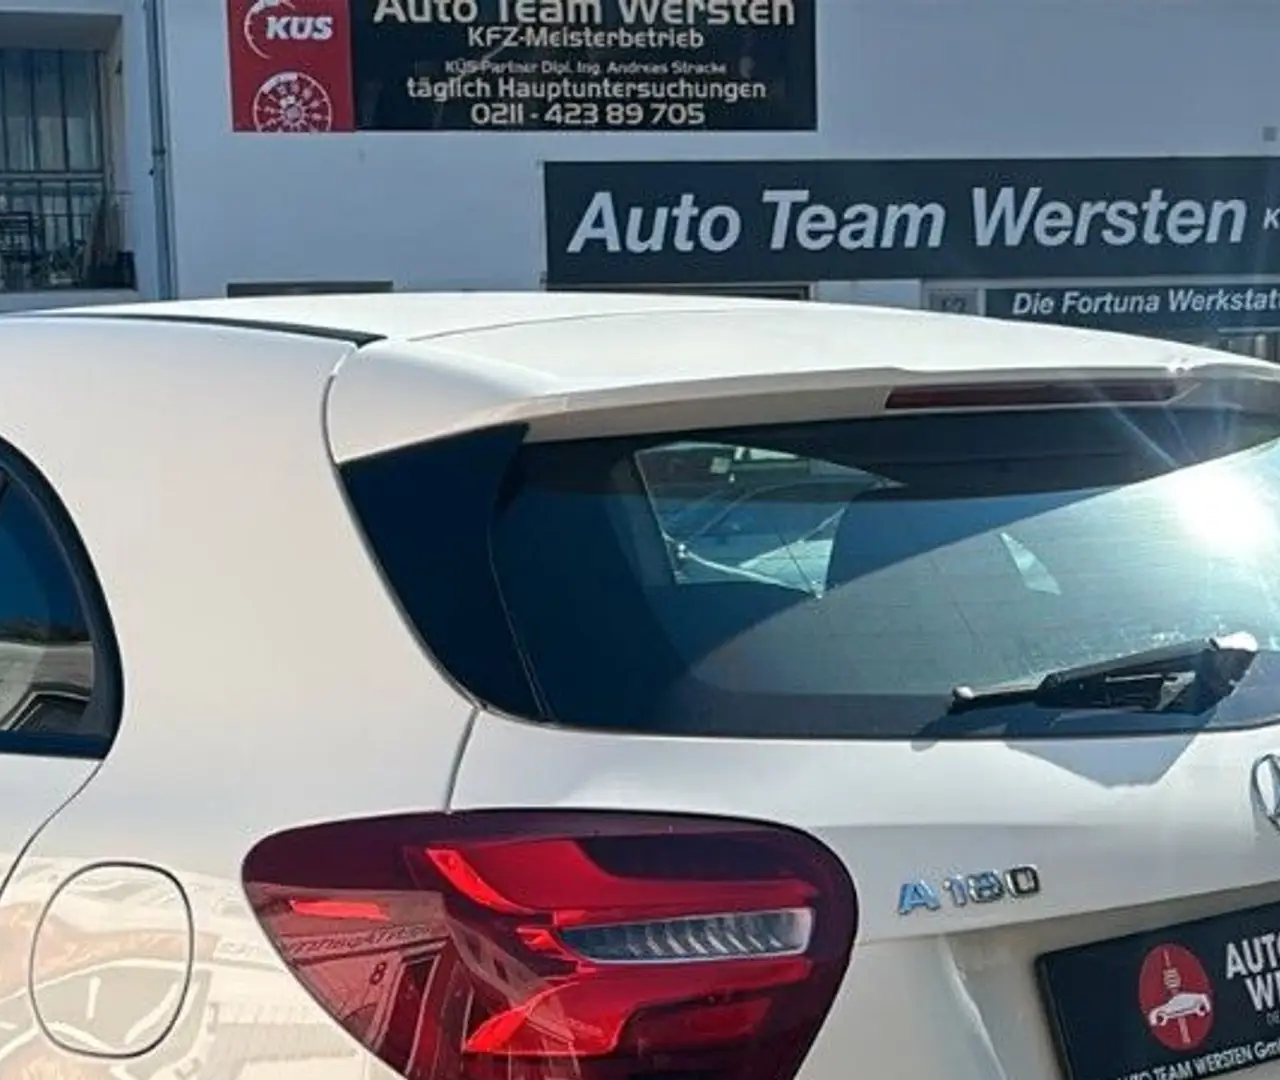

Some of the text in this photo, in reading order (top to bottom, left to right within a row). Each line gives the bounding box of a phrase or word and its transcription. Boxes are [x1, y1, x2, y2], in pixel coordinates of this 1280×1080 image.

[374, 0, 795, 25] Auto Team Wersten
[468, 26, 704, 48] KFZ-Meisterbetrieb
[407, 77, 766, 103] täglich Hauptuntersuchungen
[471, 103, 525, 125] 0211
[544, 103, 599, 125] 423
[606, 103, 644, 125] 89
[649, 103, 705, 125] 705
[566, 191, 742, 254] Auto
[762, 189, 946, 251] Team
[972, 186, 1248, 247] Wersten
[1012, 291, 1053, 316] Die
[1061, 290, 1160, 315] Fortuna
[898, 864, 1041, 916] A 180
[1194, 1044, 1254, 1075] WERSTEN
